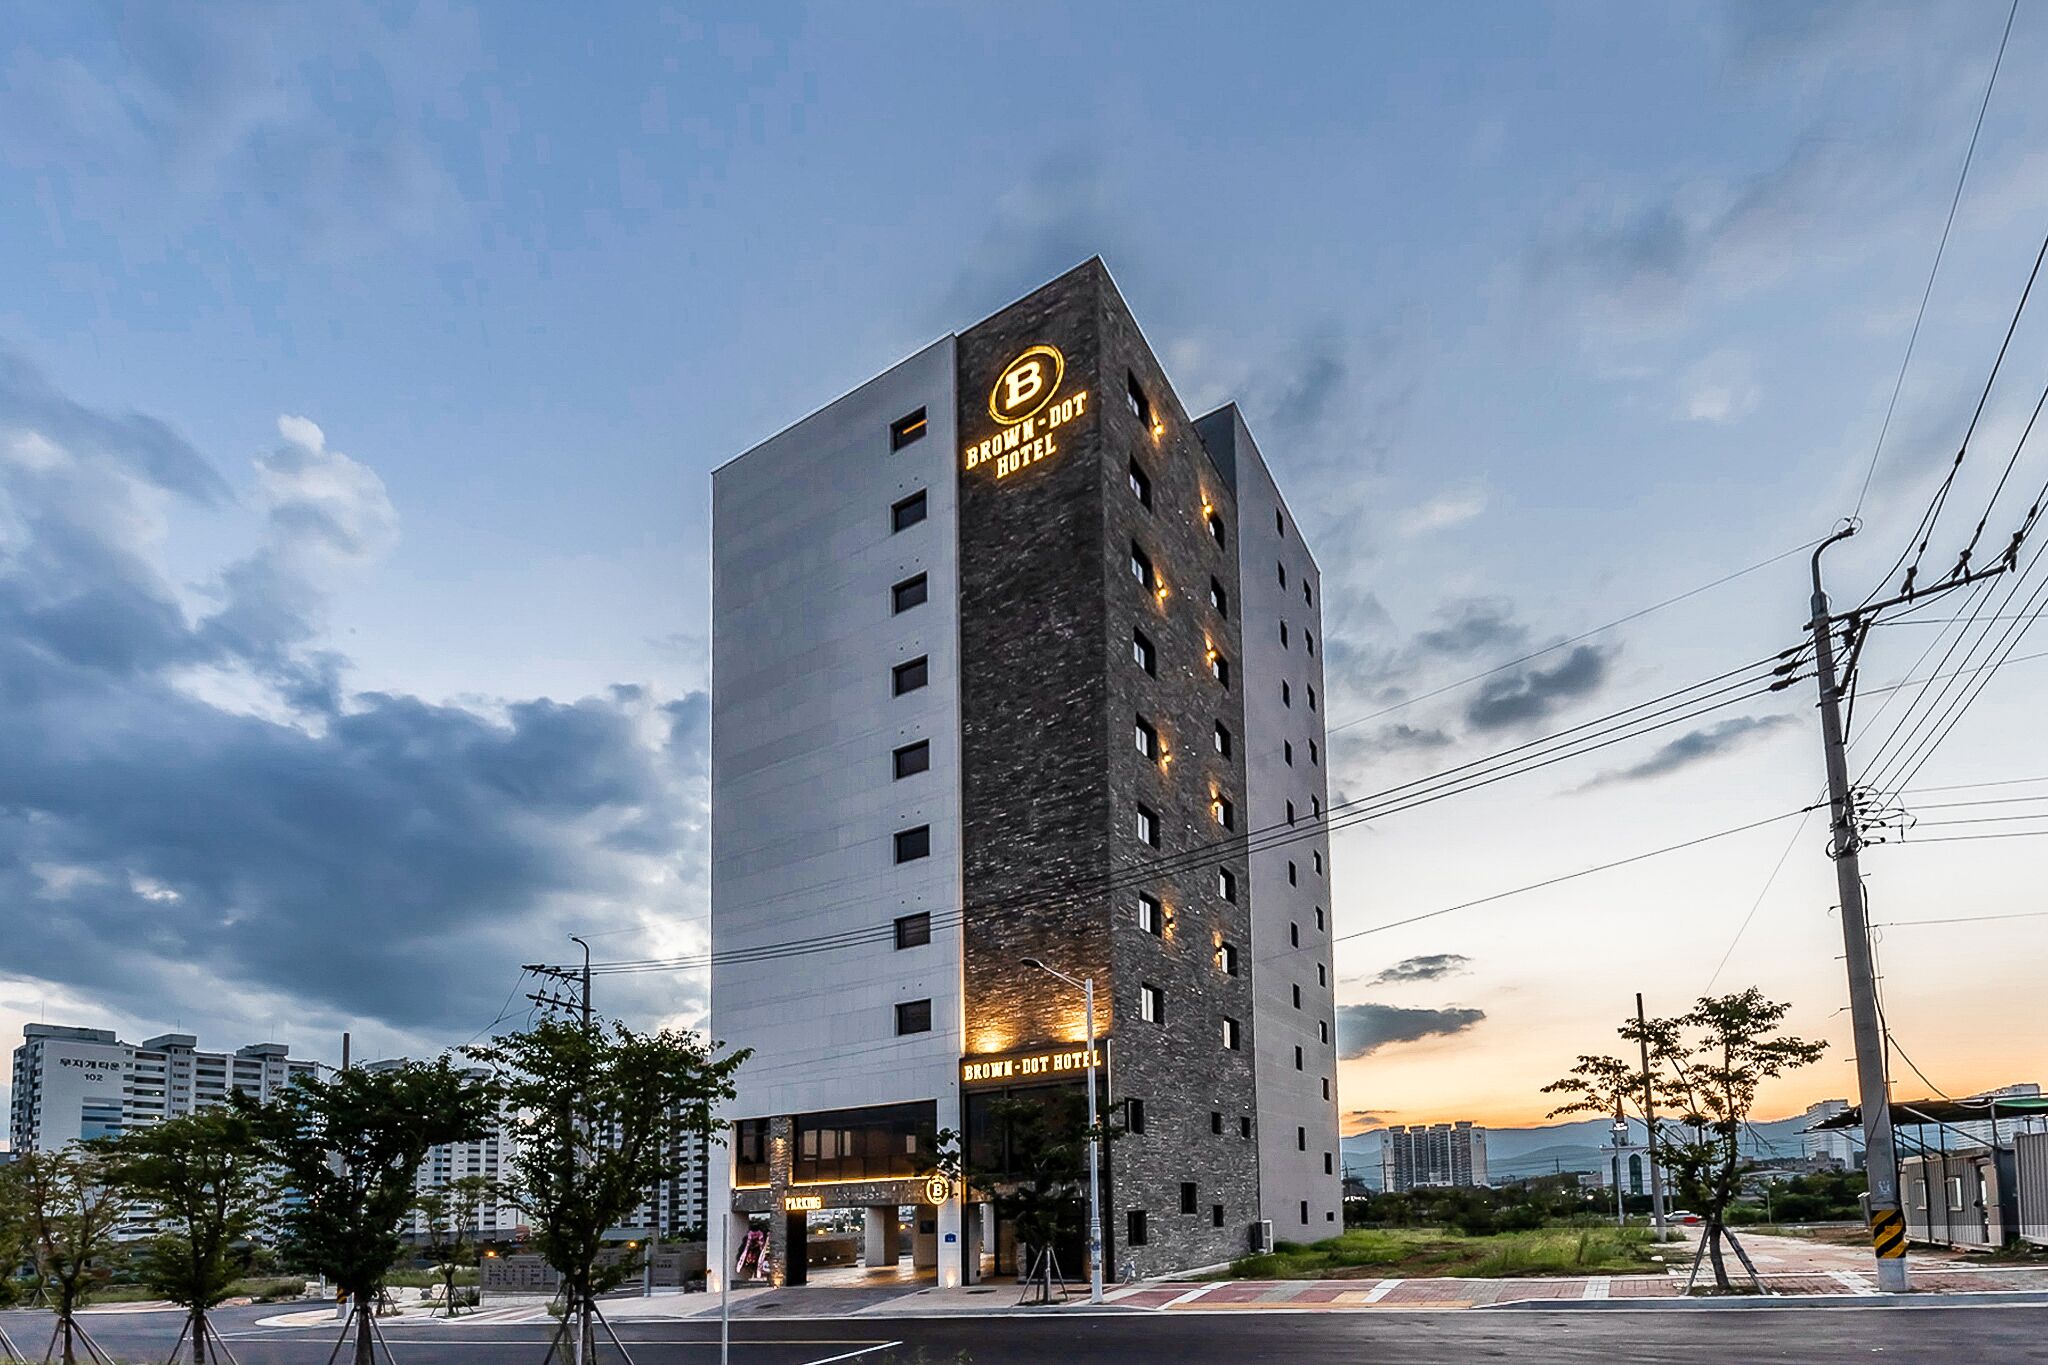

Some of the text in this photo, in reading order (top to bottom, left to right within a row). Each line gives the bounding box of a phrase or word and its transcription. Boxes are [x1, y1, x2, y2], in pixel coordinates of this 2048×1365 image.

[1005, 361, 1042, 410] B
[996, 432, 1057, 479] HOTEL
[1053, 1050, 1102, 1071] HOTEL
[84, 1073, 103, 1082] 102
[785, 1196, 822, 1210] PARKING
